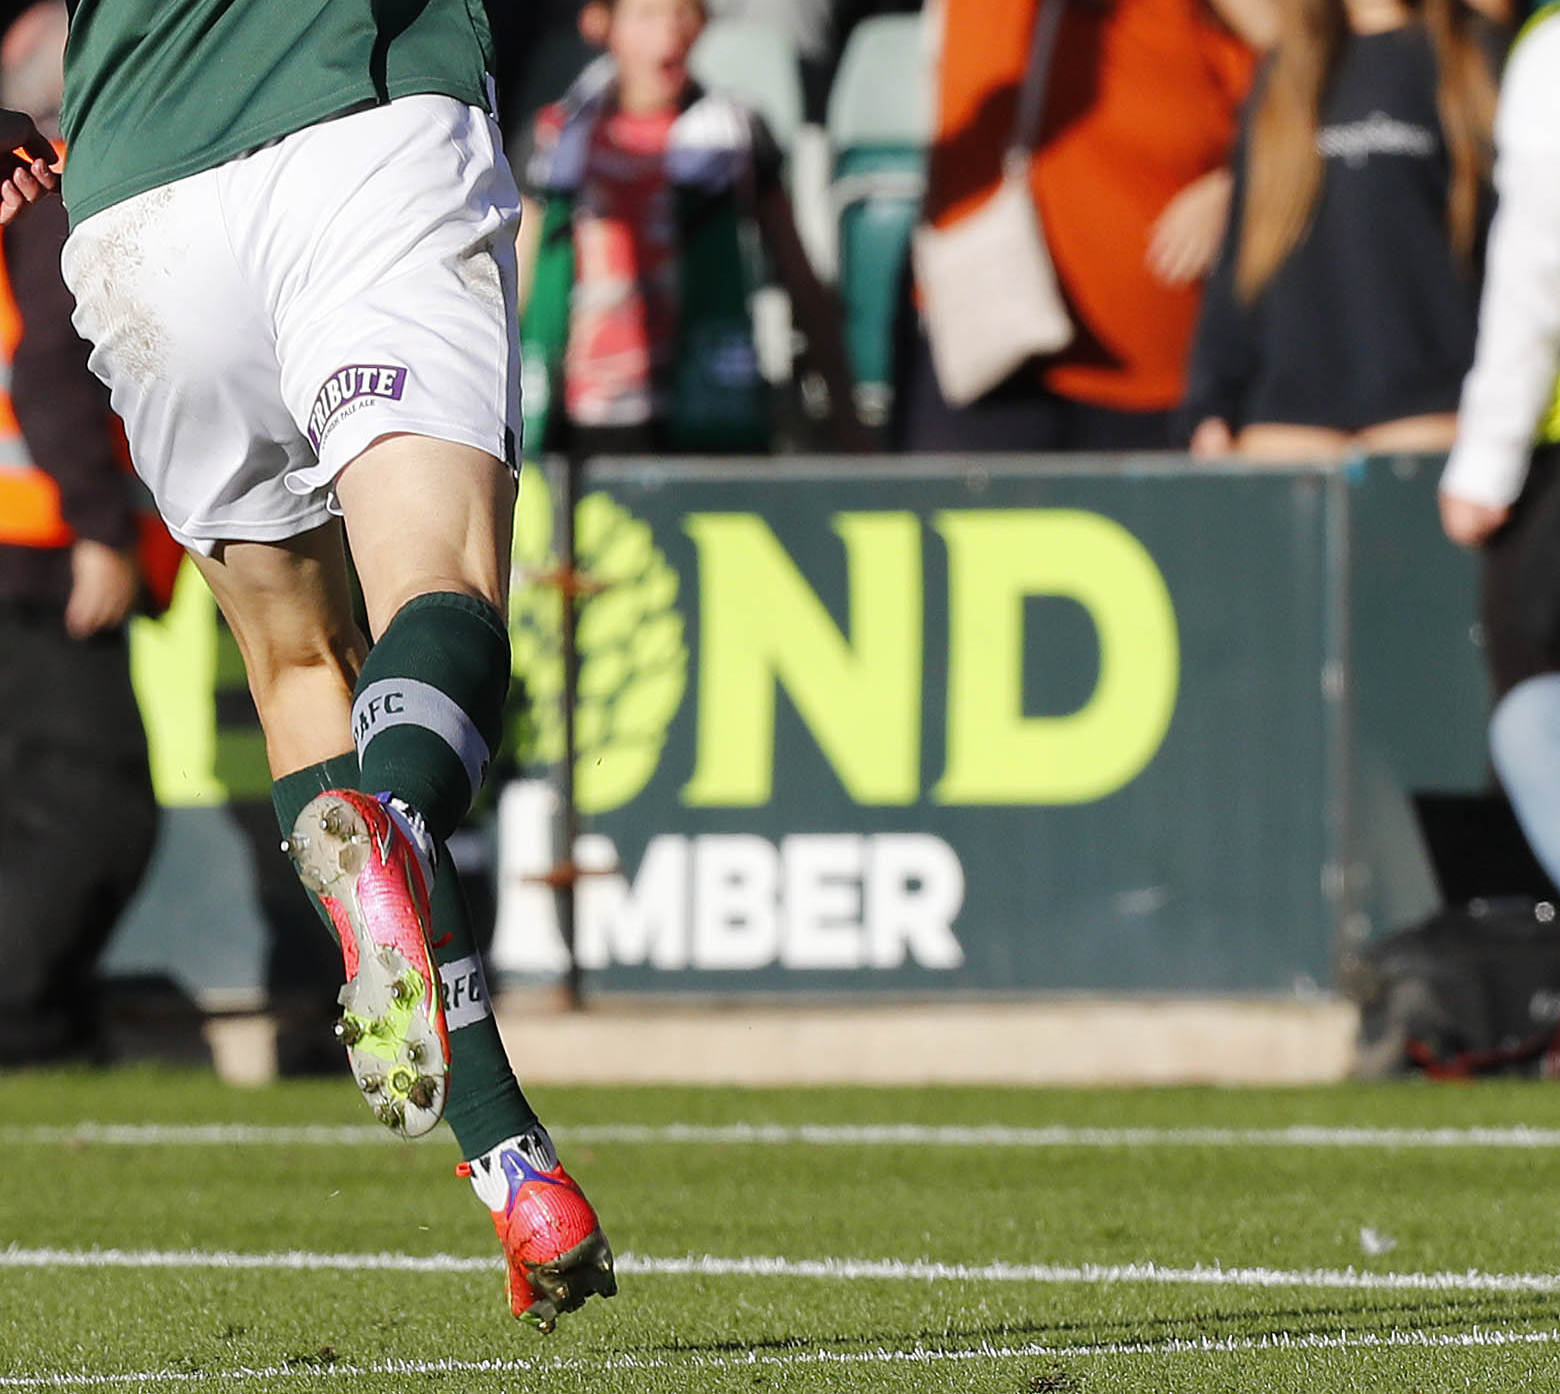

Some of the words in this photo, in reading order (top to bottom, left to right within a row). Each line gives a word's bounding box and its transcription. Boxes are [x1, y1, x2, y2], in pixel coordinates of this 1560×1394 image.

[309, 367, 397, 444] TRIBUTE
[341, 404, 356, 421] PALE
[359, 398, 376, 410] ALE
